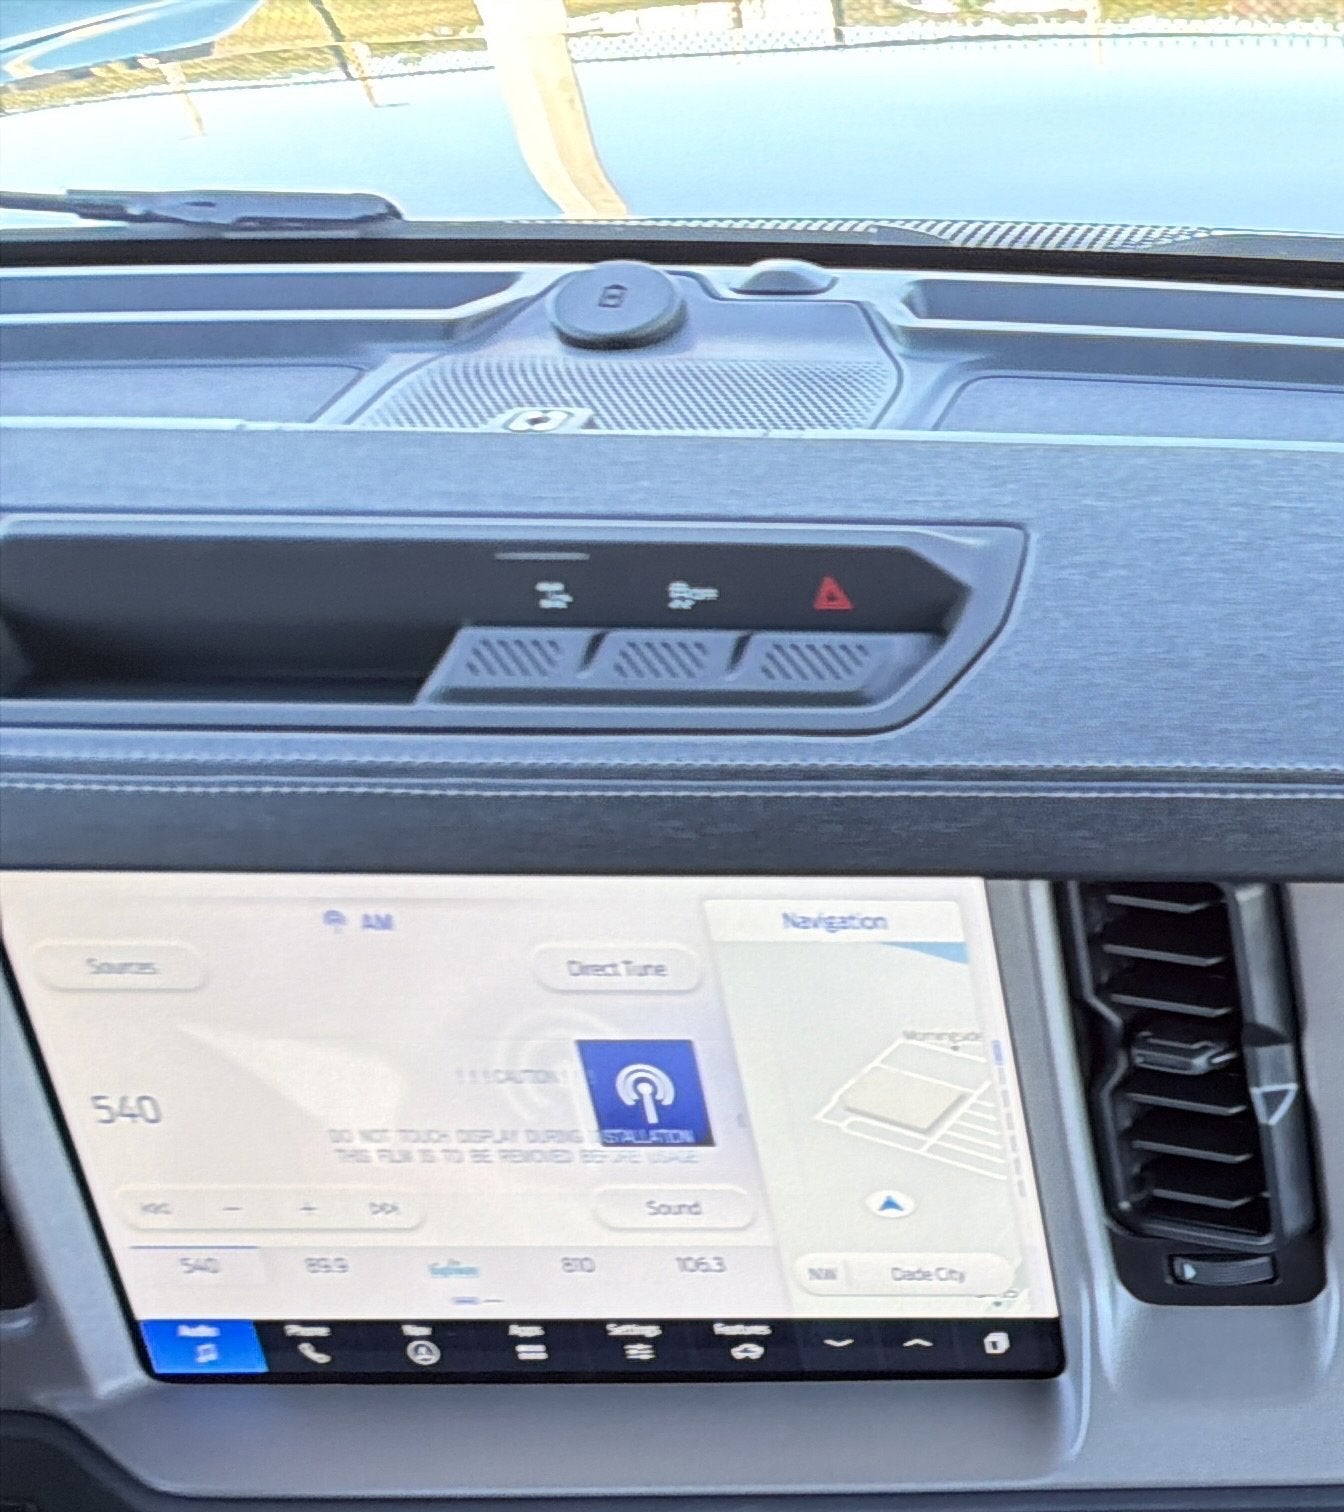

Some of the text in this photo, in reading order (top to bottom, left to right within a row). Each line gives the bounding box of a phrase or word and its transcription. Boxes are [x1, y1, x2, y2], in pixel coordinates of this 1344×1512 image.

[781, 911, 888, 933] Navigation
[86, 957, 159, 975] Sources
[566, 960, 668, 977] Direct Tune
[91, 1094, 162, 1124] 540
[646, 1200, 702, 1216] Sound
[935, 1267, 966, 1284] City
